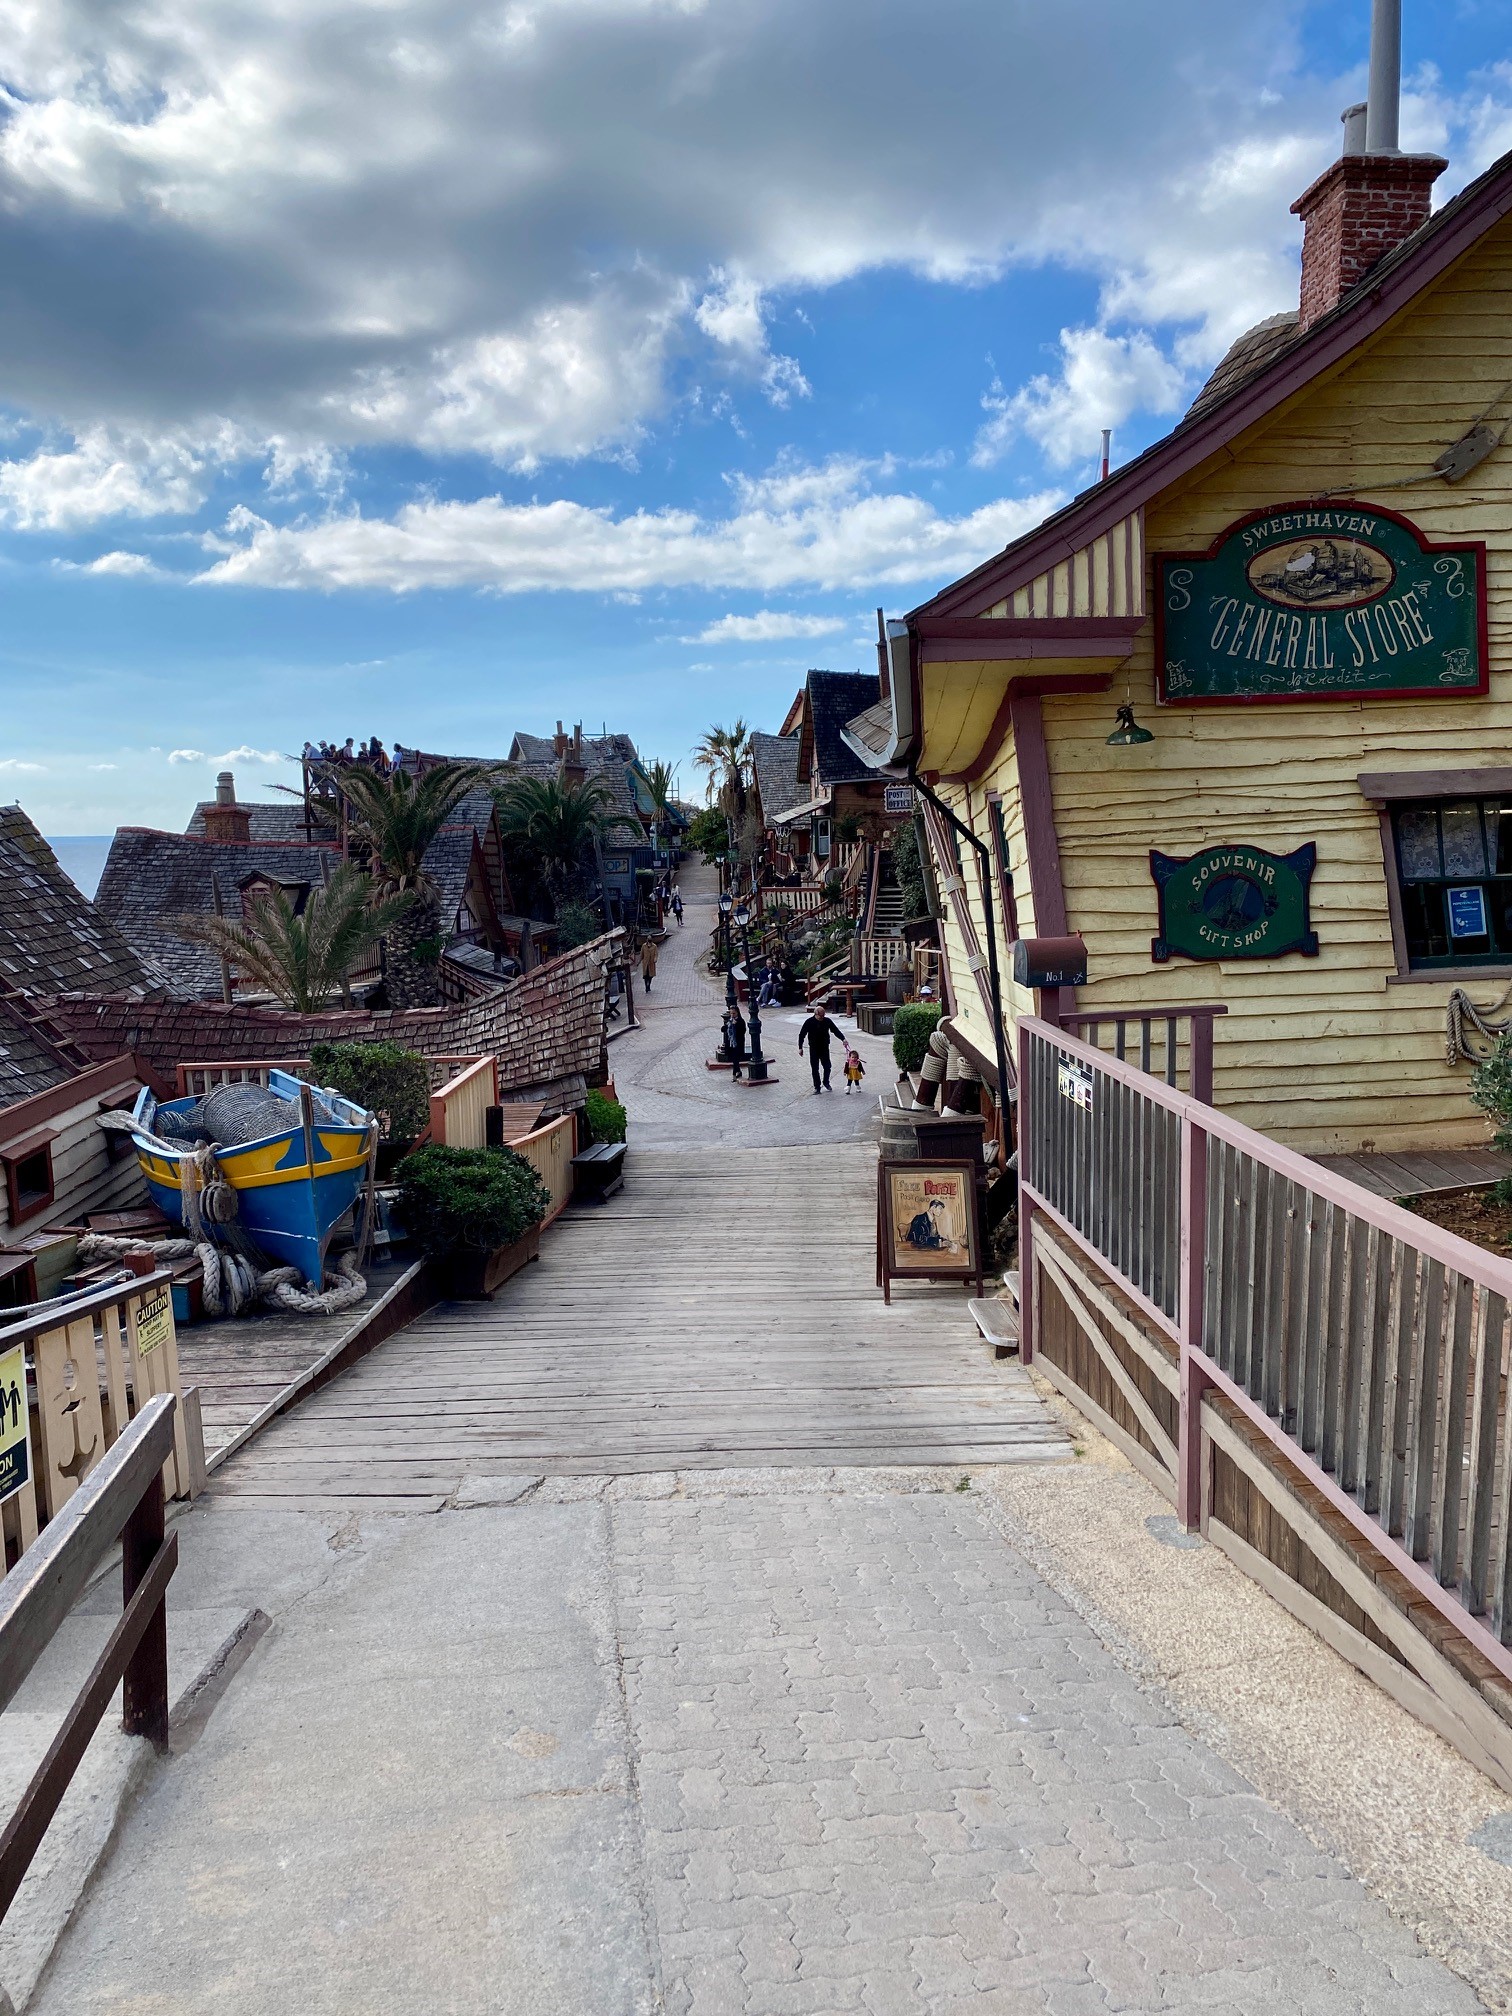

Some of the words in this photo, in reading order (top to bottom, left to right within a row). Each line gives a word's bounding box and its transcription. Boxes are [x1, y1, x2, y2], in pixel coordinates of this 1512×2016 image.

[1242, 513, 1376, 547] SWEETHAVEN
[1210, 598, 1334, 669] GENERAL
[1344, 591, 1434, 667] STORE
[888, 791, 904, 799] POST
[888, 800, 911, 808] OFFICE
[1192, 855, 1276, 891] SOUVENIR
[1199, 925, 1230, 947] GIFT
[1233, 921, 1269, 948] SHOP
[1046, 970, 1063, 982] No.1
[924, 1179, 957, 1196] POPEYE
[136, 1294, 168, 1325] CAUTION
